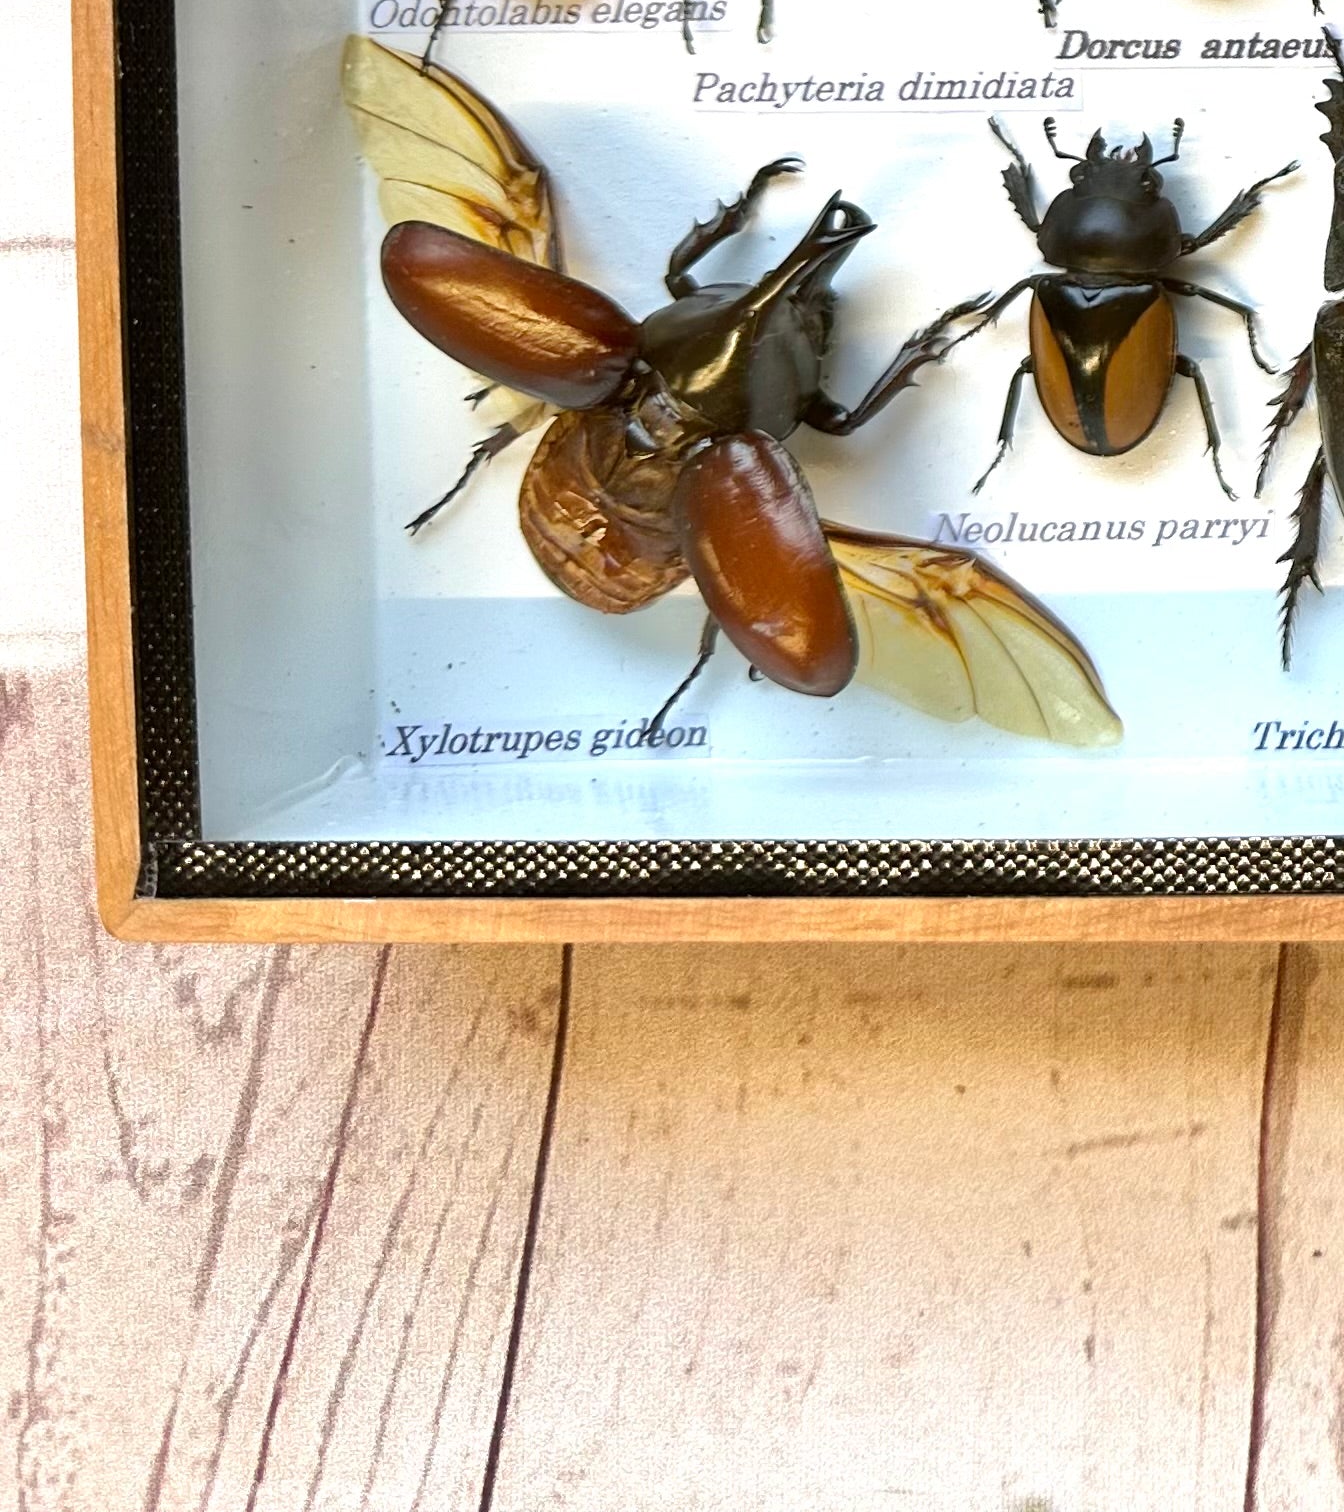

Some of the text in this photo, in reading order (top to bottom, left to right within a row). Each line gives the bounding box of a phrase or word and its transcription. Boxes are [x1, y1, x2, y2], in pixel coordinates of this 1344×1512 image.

[1055, 30, 1182, 61] Dorcus
[692, 69, 1076, 108] Pachyteria dimidiata
[932, 511, 1271, 546] Neolucanus parryi
[385, 717, 707, 762] Xylotrupes gideon
